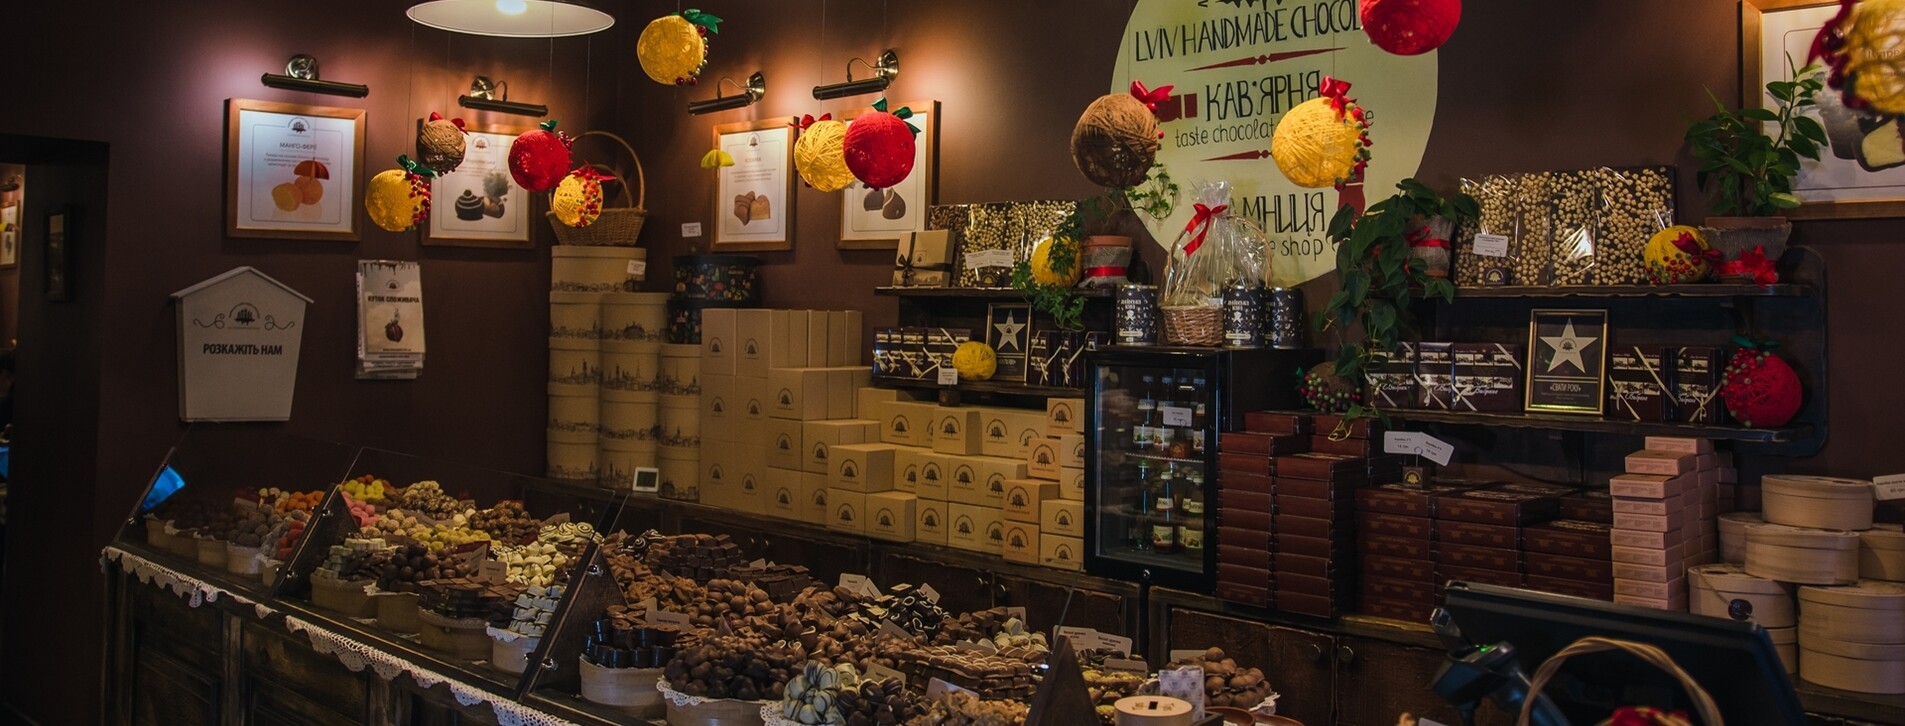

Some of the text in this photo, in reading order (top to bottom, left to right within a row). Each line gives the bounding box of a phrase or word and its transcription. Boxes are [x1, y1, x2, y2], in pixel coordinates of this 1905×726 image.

[1135, 0, 1361, 62] LVIV HANDMADE CHOCOL
[1175, 118, 1277, 149] taste chocolat
[1280, 235, 1324, 262] shop
[203, 343, 283, 355] РОЗКАЖІТЬ НАМ
